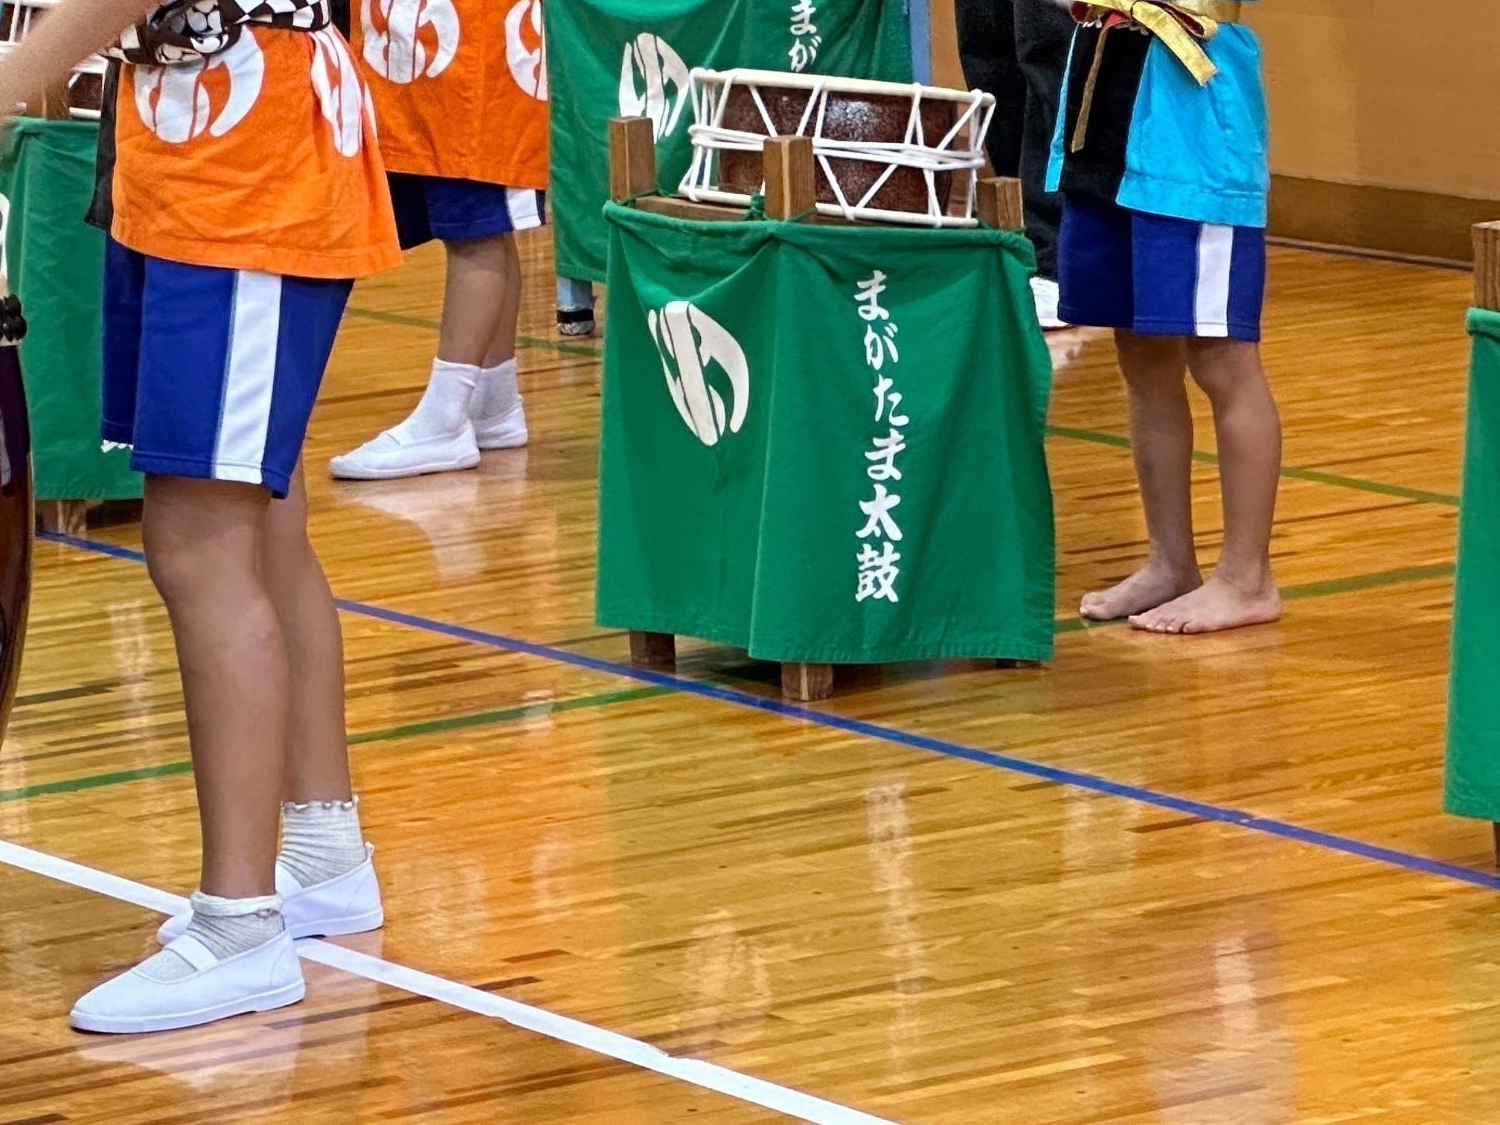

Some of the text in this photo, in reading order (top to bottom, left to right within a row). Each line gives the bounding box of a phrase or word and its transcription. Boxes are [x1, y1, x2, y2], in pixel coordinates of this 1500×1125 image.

[853, 269, 910, 604] まがたま太鼓
